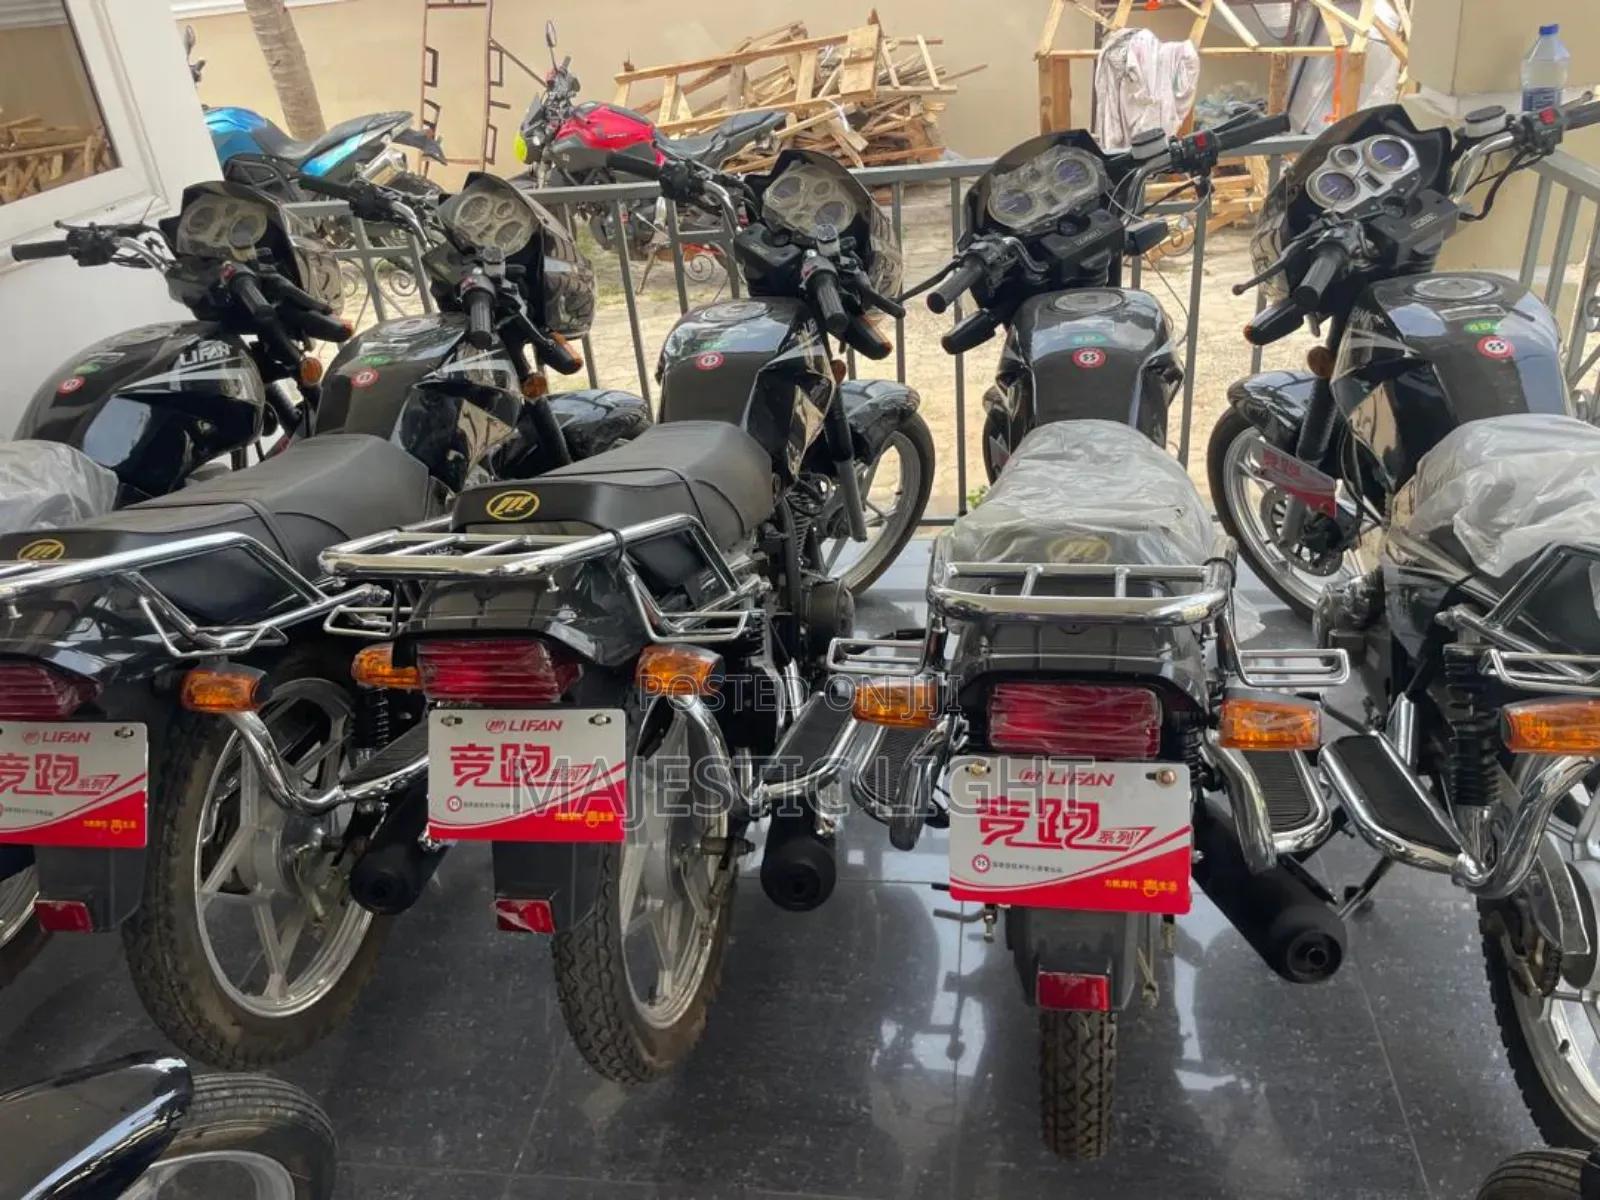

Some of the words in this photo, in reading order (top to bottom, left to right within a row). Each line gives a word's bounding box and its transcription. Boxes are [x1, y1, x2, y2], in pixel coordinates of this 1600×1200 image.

[179, 341, 231, 366] LIFAN
[509, 719, 563, 732] LIFAN
[42, 731, 91, 744] LIFAN
[1047, 772, 1115, 787] LIFAN
